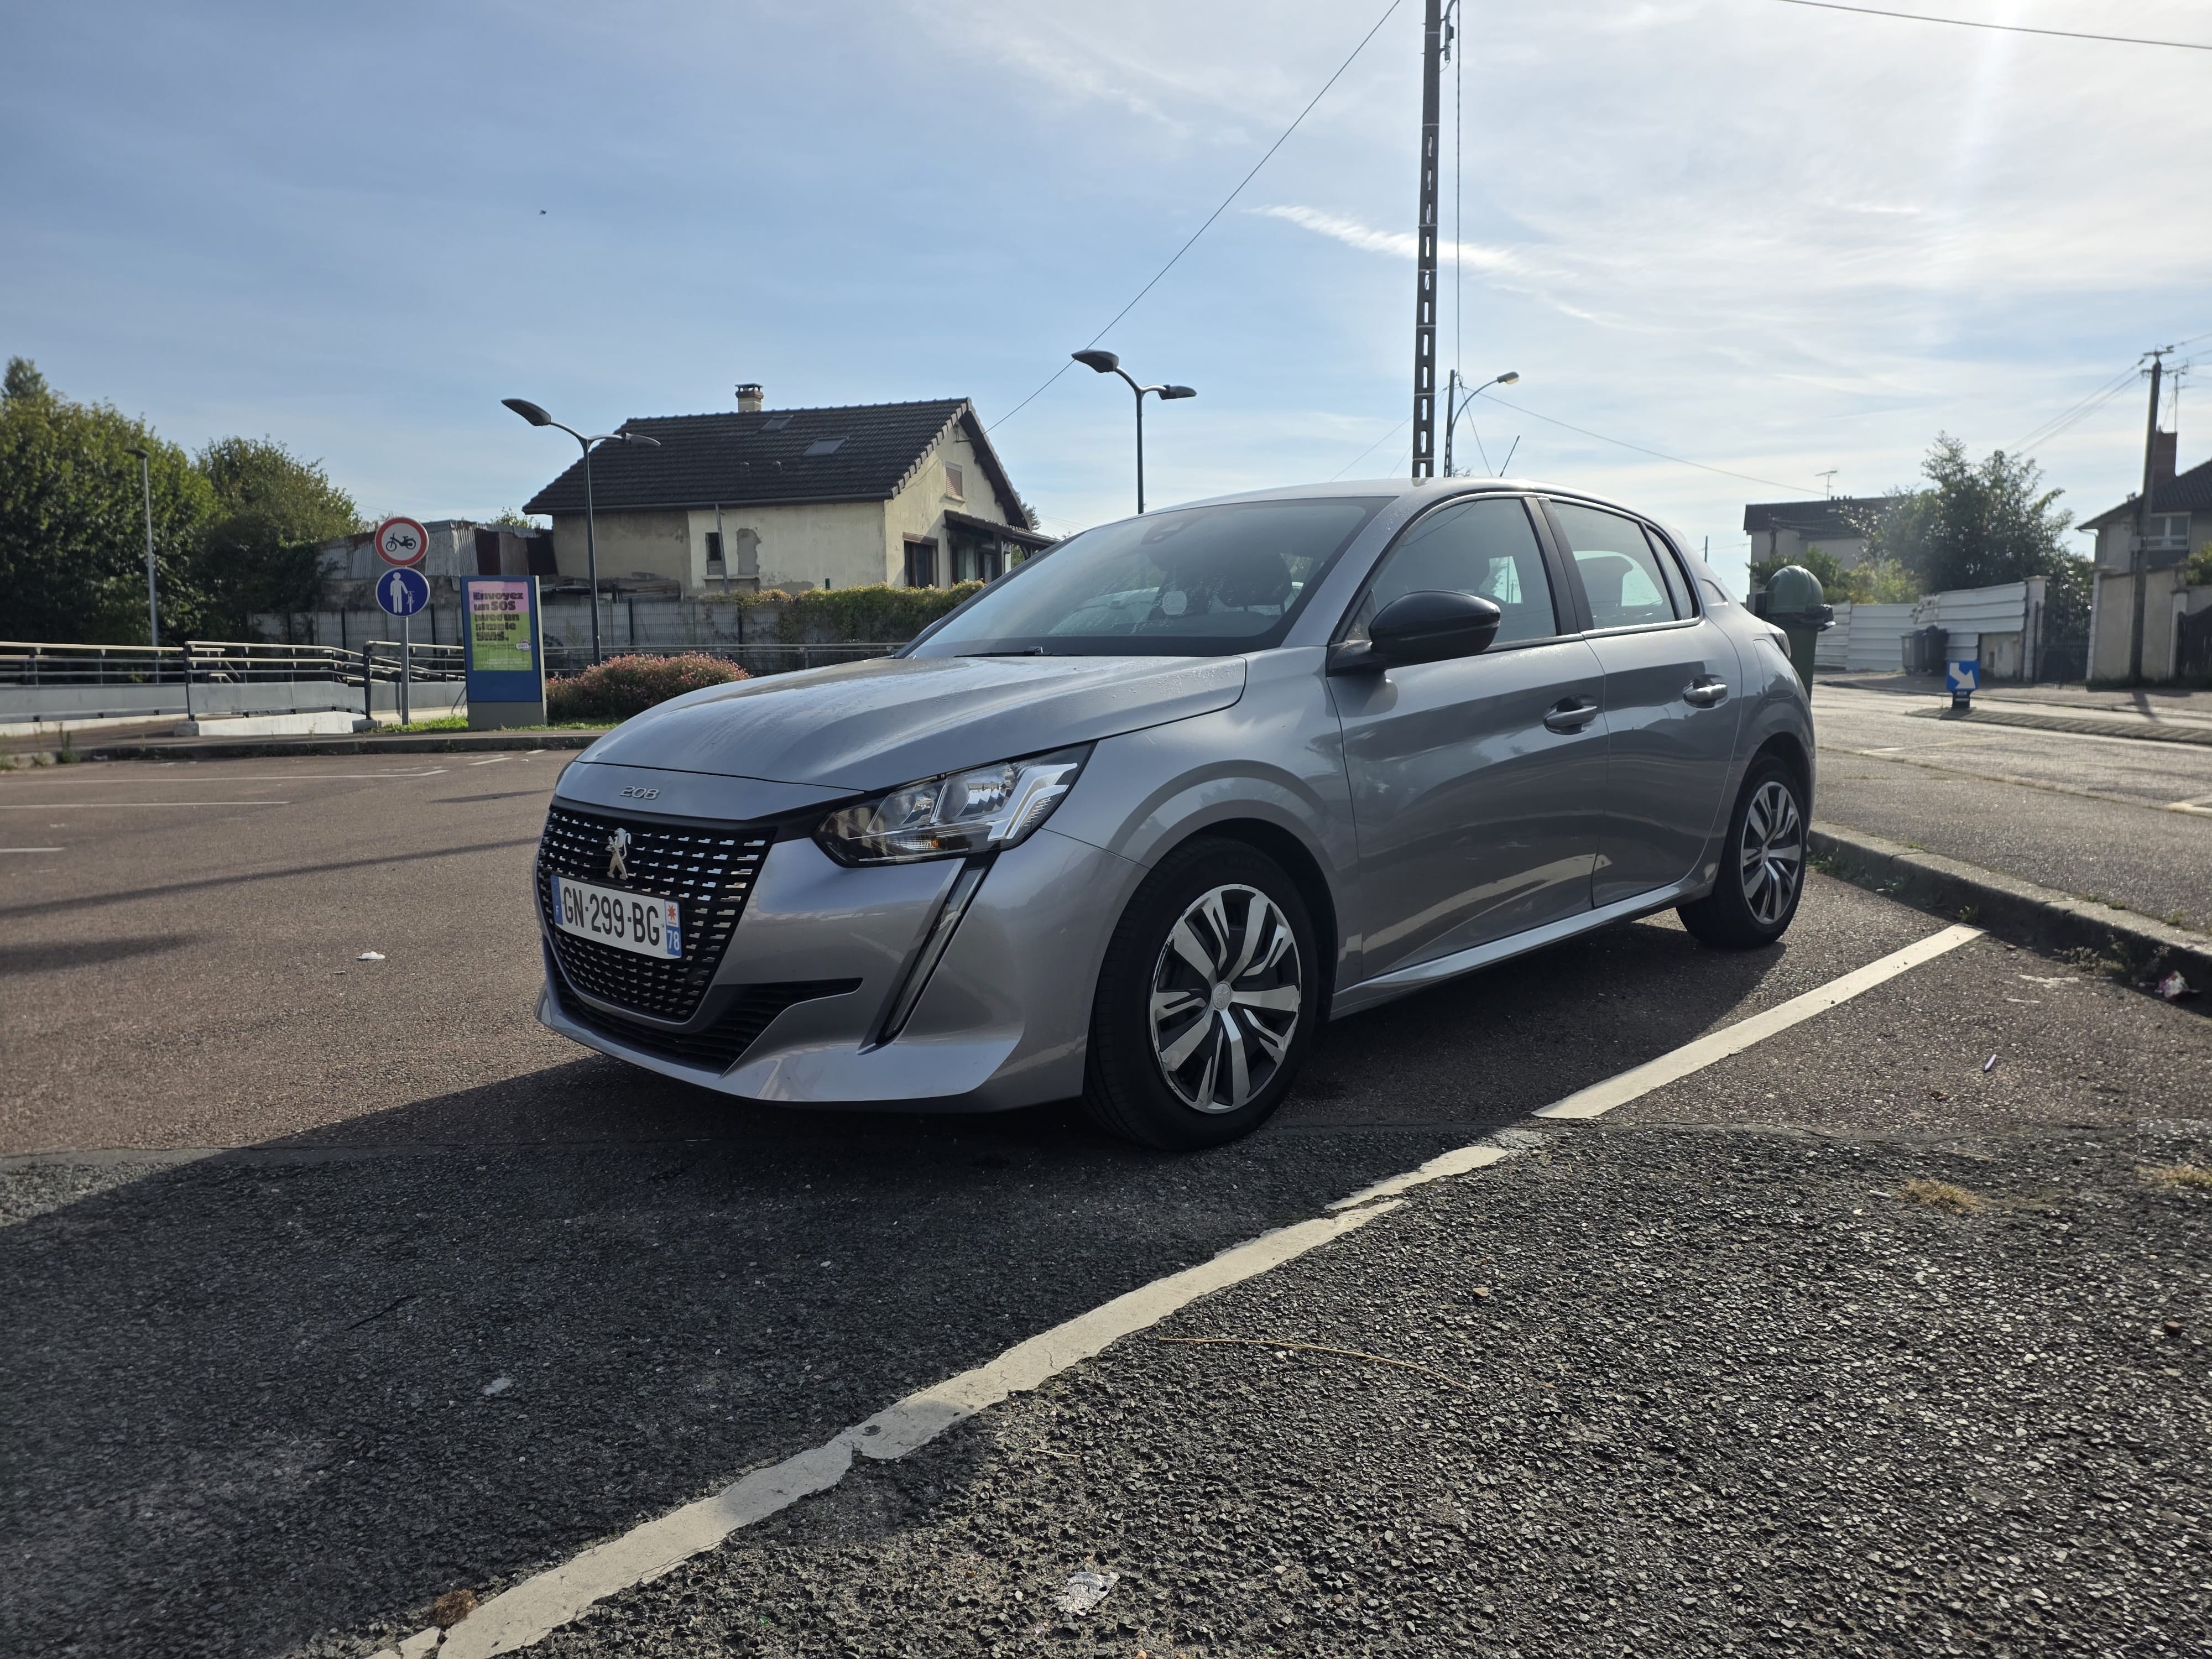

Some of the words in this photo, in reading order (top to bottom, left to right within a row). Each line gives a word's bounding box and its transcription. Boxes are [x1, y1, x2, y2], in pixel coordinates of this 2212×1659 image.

[491, 601, 516, 611] SOS
[620, 786, 660, 799] 208
[555, 906, 559, 915] F
[564, 886, 660, 946] GN-299-BG
[667, 930, 680, 951] 78
